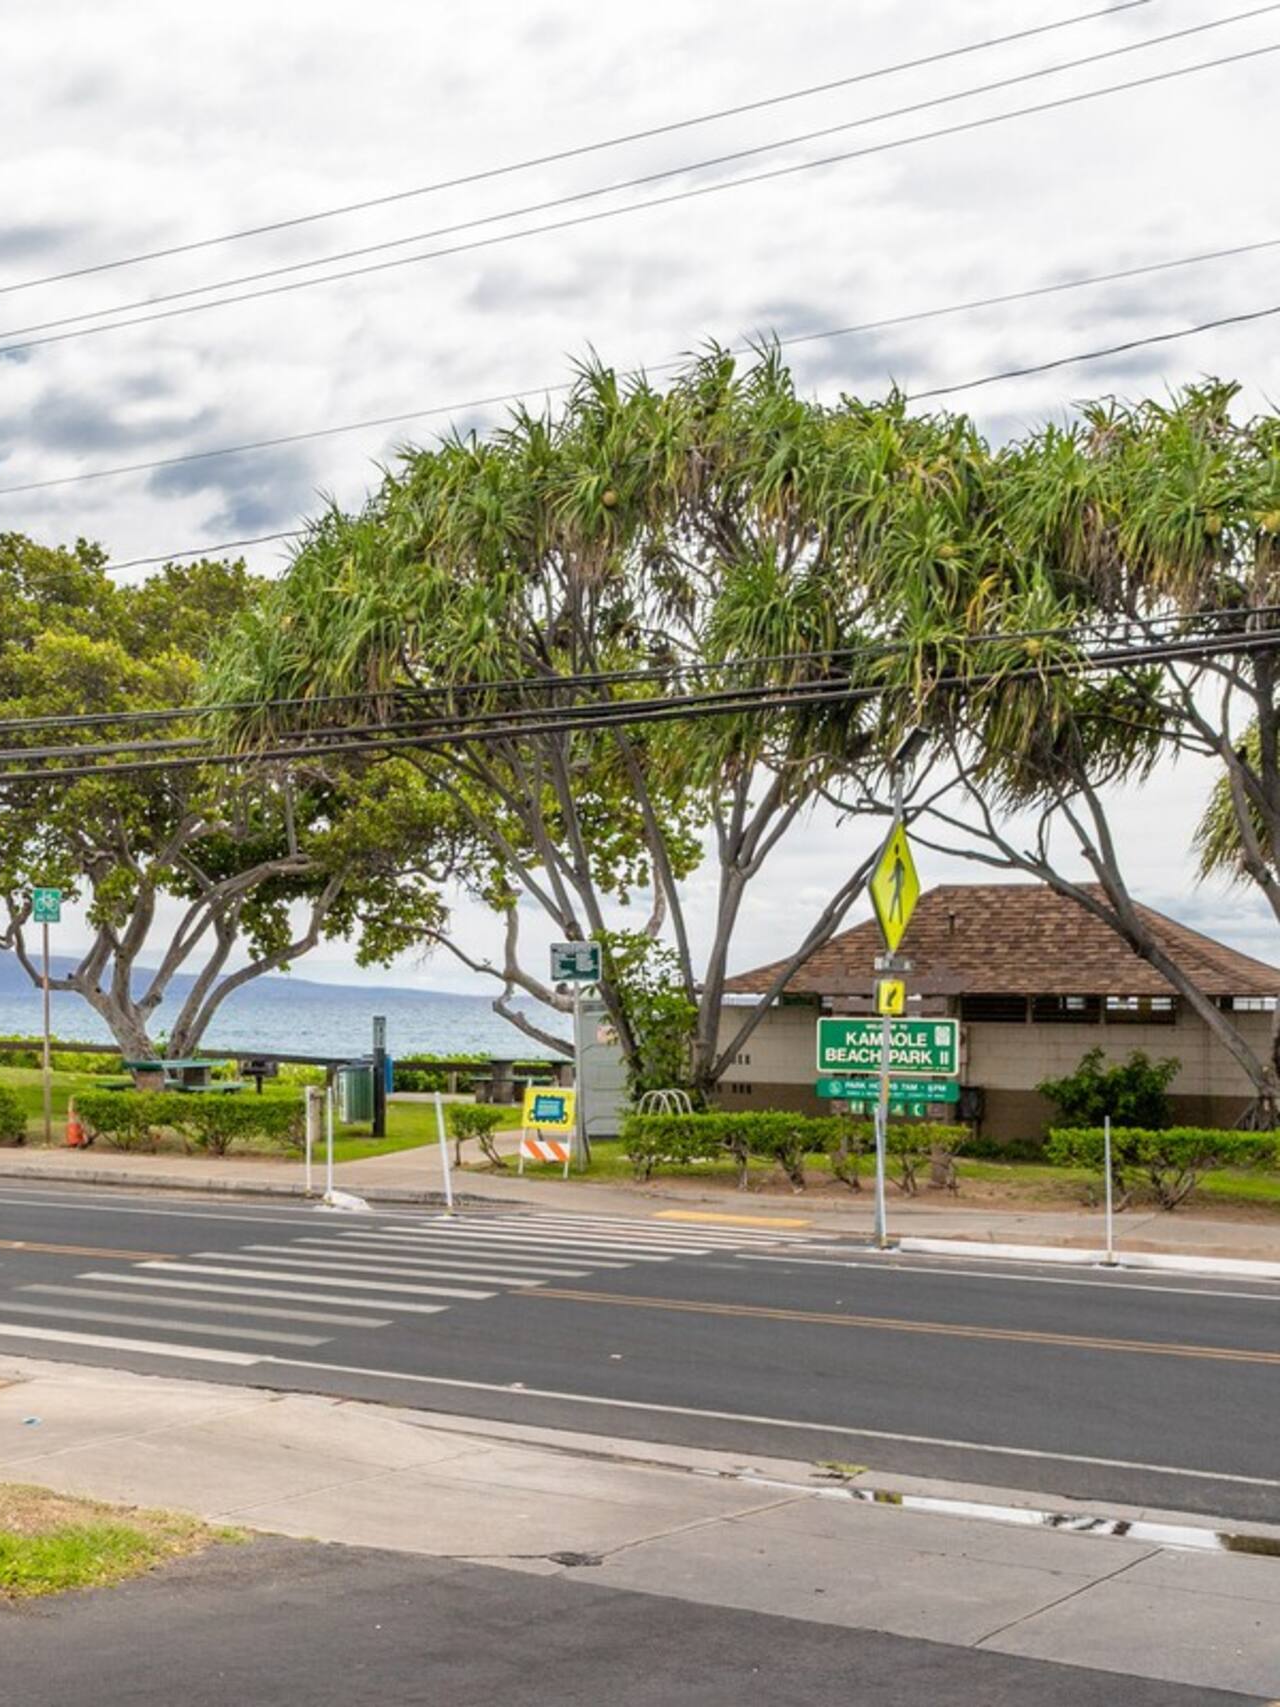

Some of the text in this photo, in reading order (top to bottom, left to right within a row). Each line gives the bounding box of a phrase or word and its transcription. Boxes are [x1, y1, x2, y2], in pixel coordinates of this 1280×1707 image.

[825, 1048, 881, 1063] BEACH
[889, 1050, 932, 1065] PARK
[868, 1083, 898, 1091] HOS
